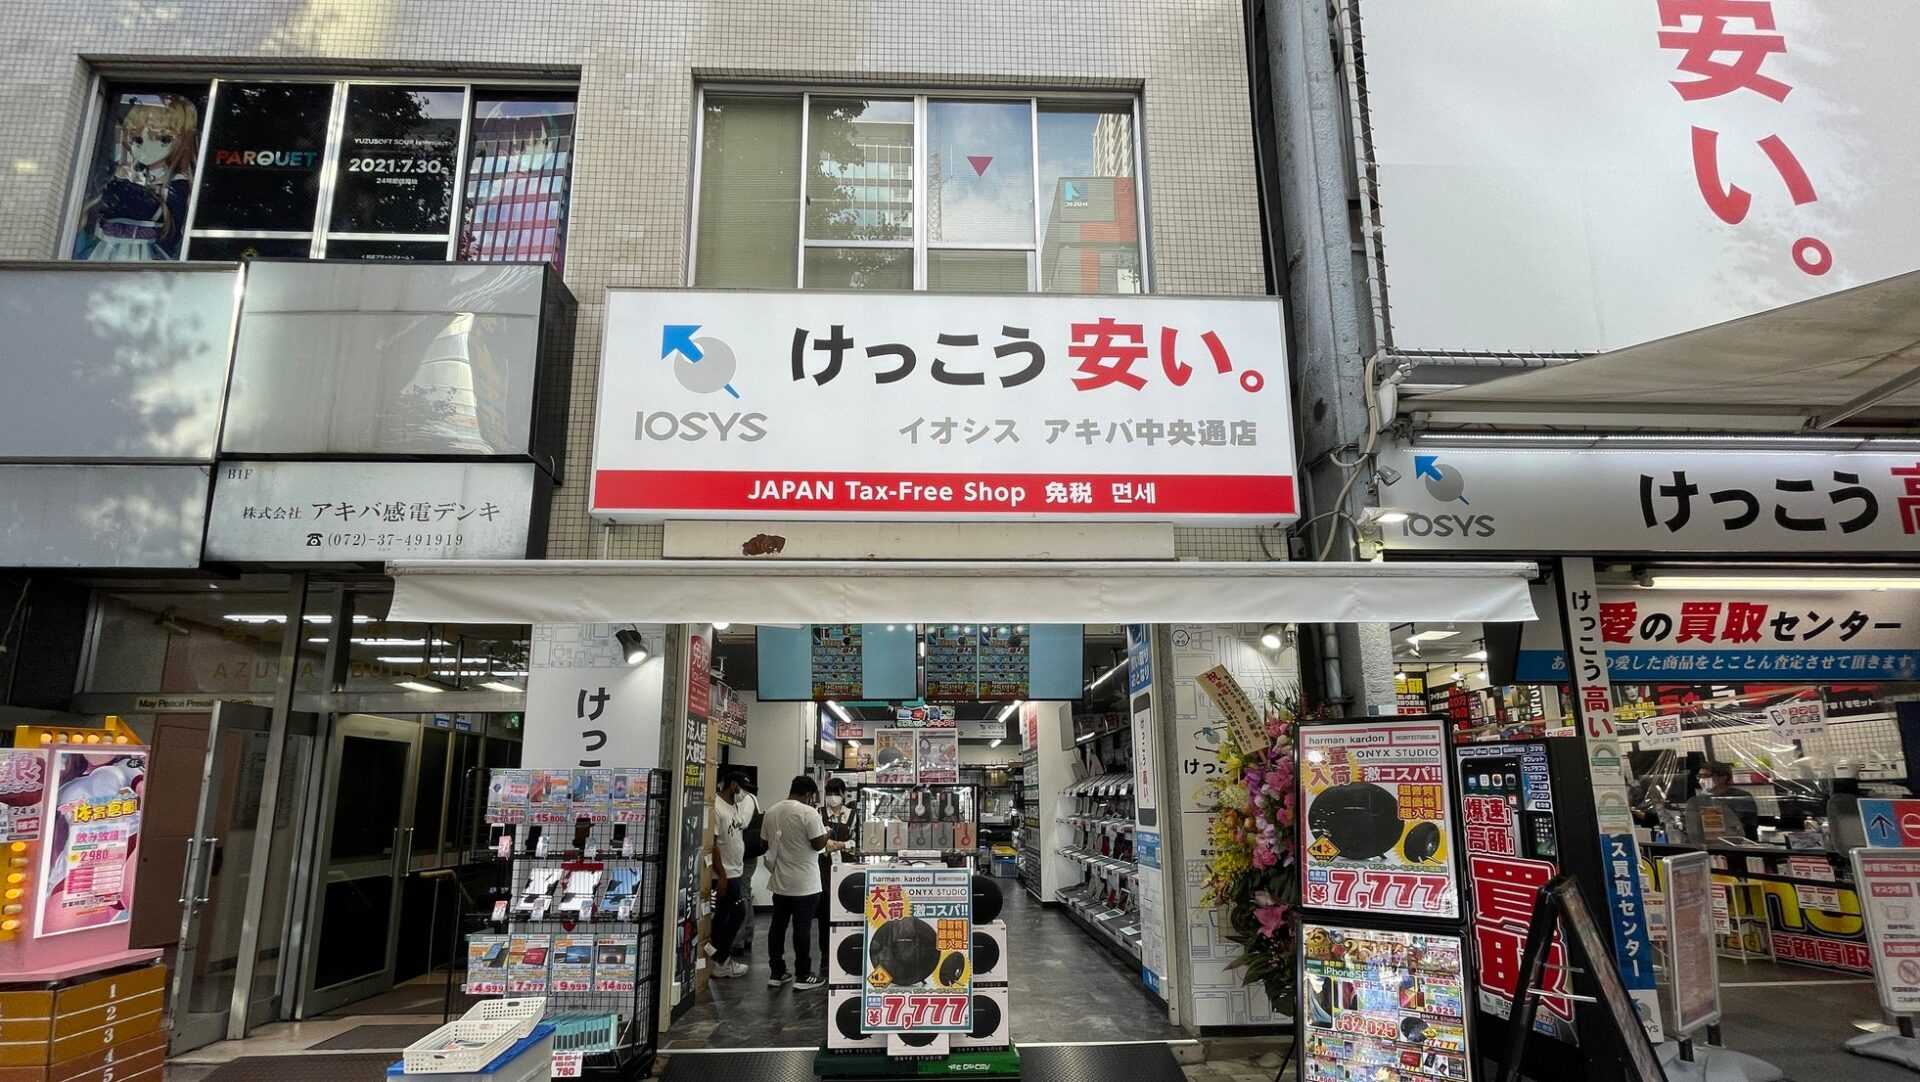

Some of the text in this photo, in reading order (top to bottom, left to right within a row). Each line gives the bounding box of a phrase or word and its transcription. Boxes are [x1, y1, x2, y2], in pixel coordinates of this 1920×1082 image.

[1657, 0, 1833, 276] 安い。
[215, 150, 318, 169] PARQUET
[791, 317, 1266, 393] けっこう 安い。
[634, 410, 768, 443] IOSYS
[898, 418, 1258, 447] イオシス アキバ中央通店
[227, 468, 253, 481] B1F
[747, 479, 1157, 508] JAPAN Tax-Free Shop 免税 면세
[1640, 469, 1879, 533] けっこう
[242, 501, 501, 523] 株式会社 アキバ感電デンキ
[1402, 513, 1495, 538] IOSYS
[327, 533, 463, 548] (072)-37-491919
[1599, 600, 1902, 645] 愛の買取センター
[1572, 590, 1613, 738] けっこう高い
[577, 687, 611, 767] けっ
[1350, 735, 1385, 743] kardon
[1307, 747, 1349, 766] 量
[1356, 748, 1439, 758] ONYX STUDIO
[1309, 765, 1351, 786] 入荷
[1464, 796, 1512, 825] 爆速!
[1468, 826, 1514, 854] 高額!
[870, 884, 903, 902] 大量
[908, 888, 967, 896] ONYX STUDIO
[871, 902, 904, 920] 入荷
[1608, 833, 1641, 978] ス買取センター
[109, 983, 117, 999] 1
[105, 1006, 117, 1021] 2
[103, 1028, 114, 1043] 3
[103, 1048, 113, 1063] 4
[103, 1068, 114, 1082] 5
